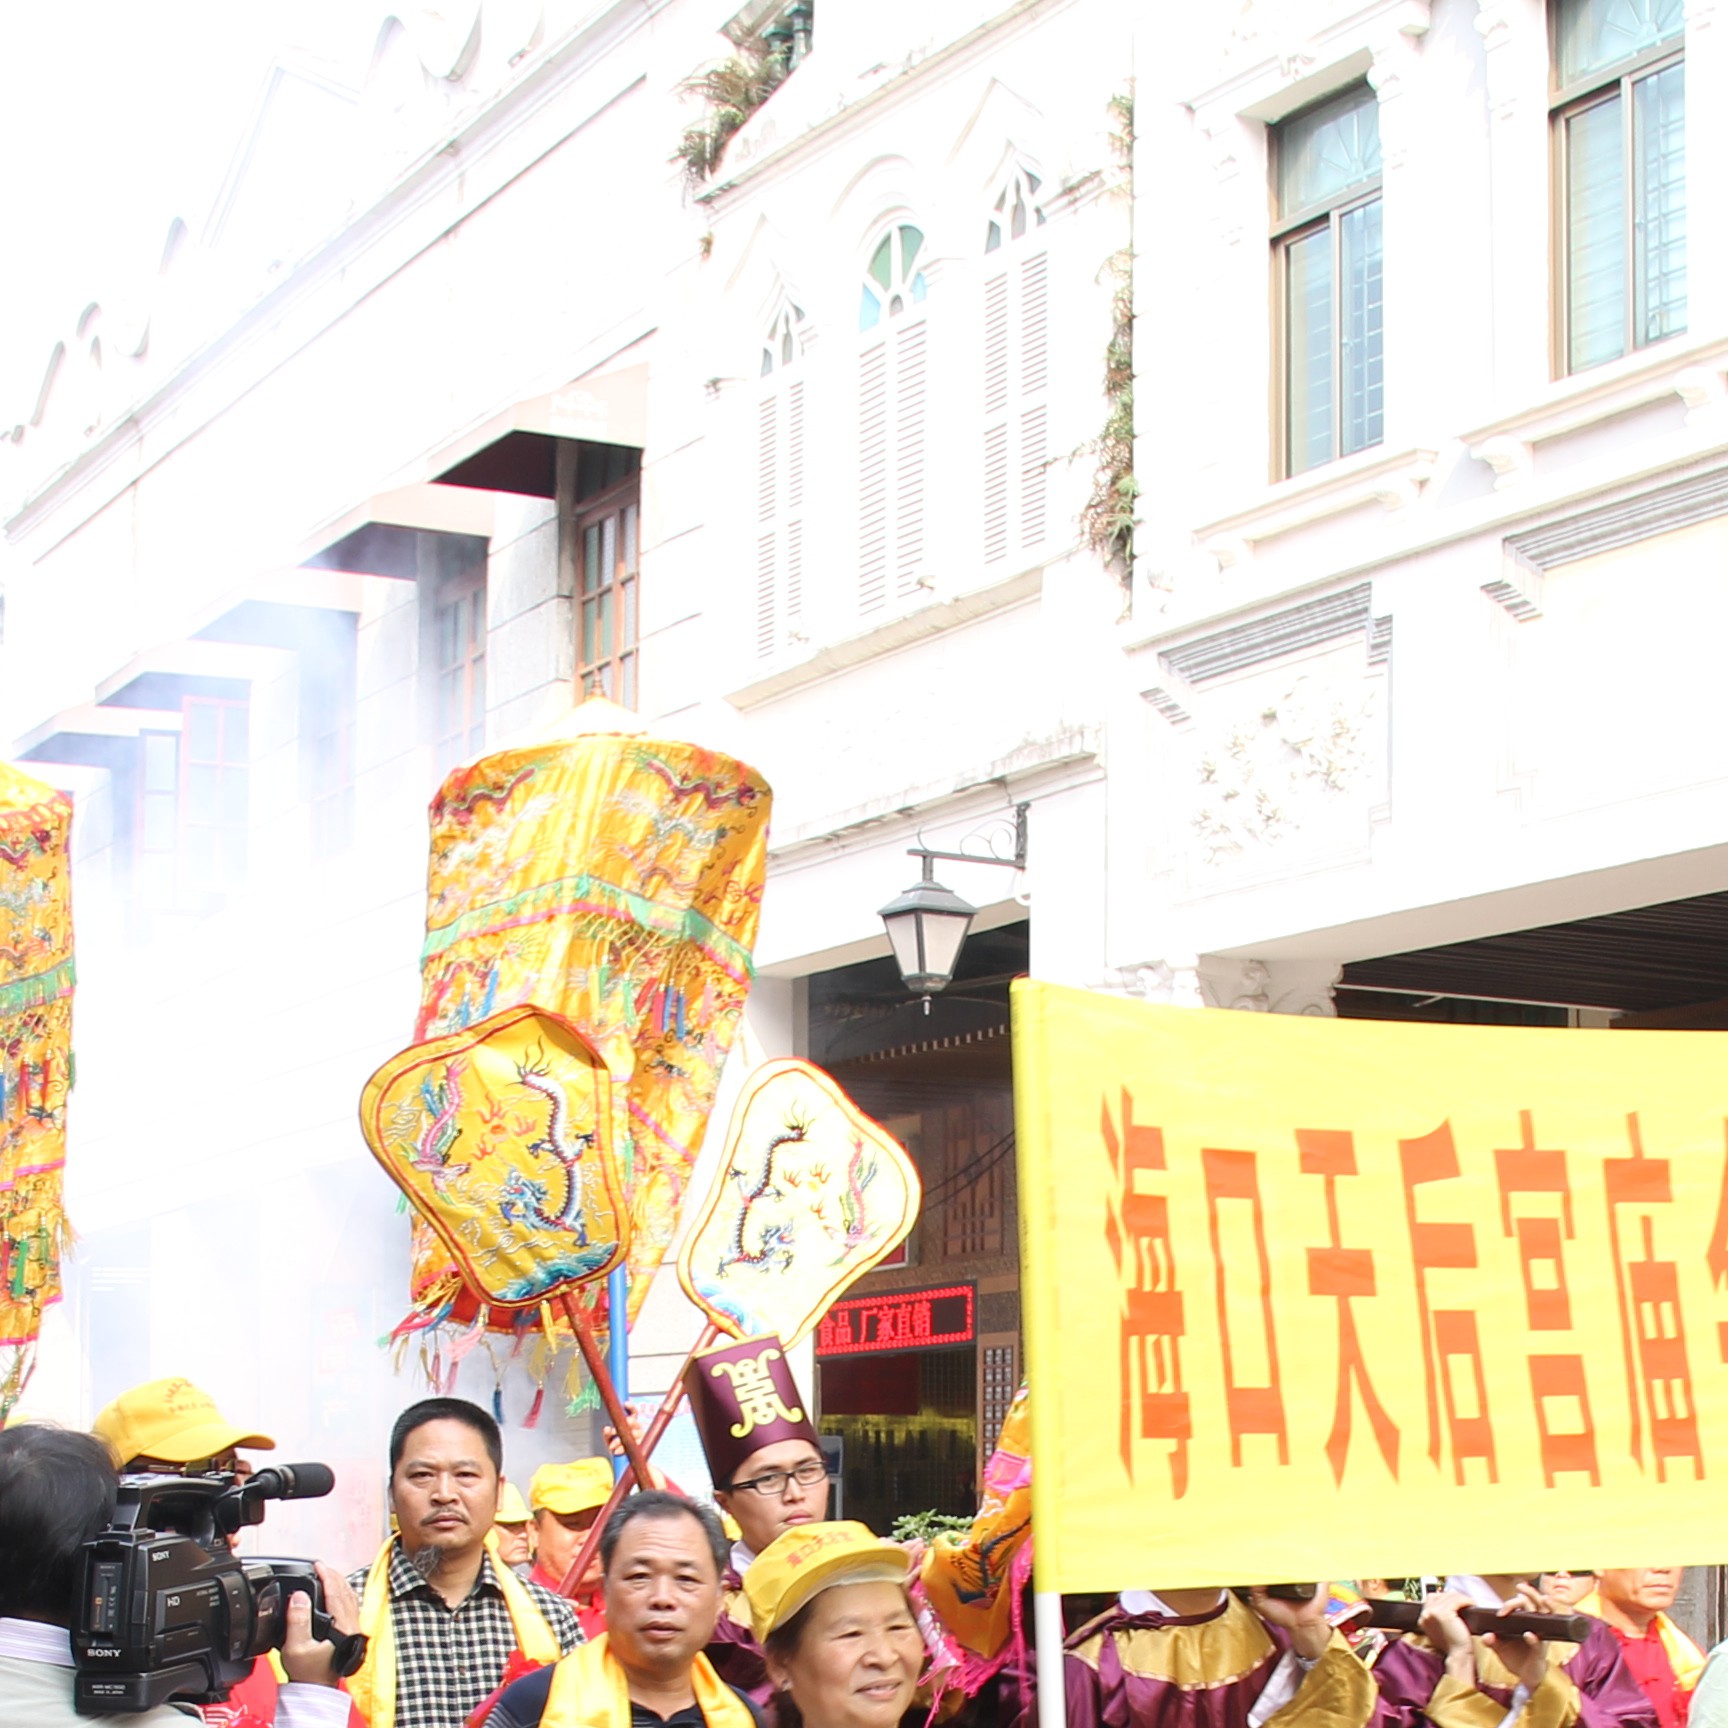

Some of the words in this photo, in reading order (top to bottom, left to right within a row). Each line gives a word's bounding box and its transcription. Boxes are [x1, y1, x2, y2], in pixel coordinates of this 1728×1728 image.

[818, 1311, 853, 1348] 食品
[859, 1300, 932, 1343] 厂家直销
[167, 1595, 181, 1608] HD
[86, 1647, 122, 1658] SONY
